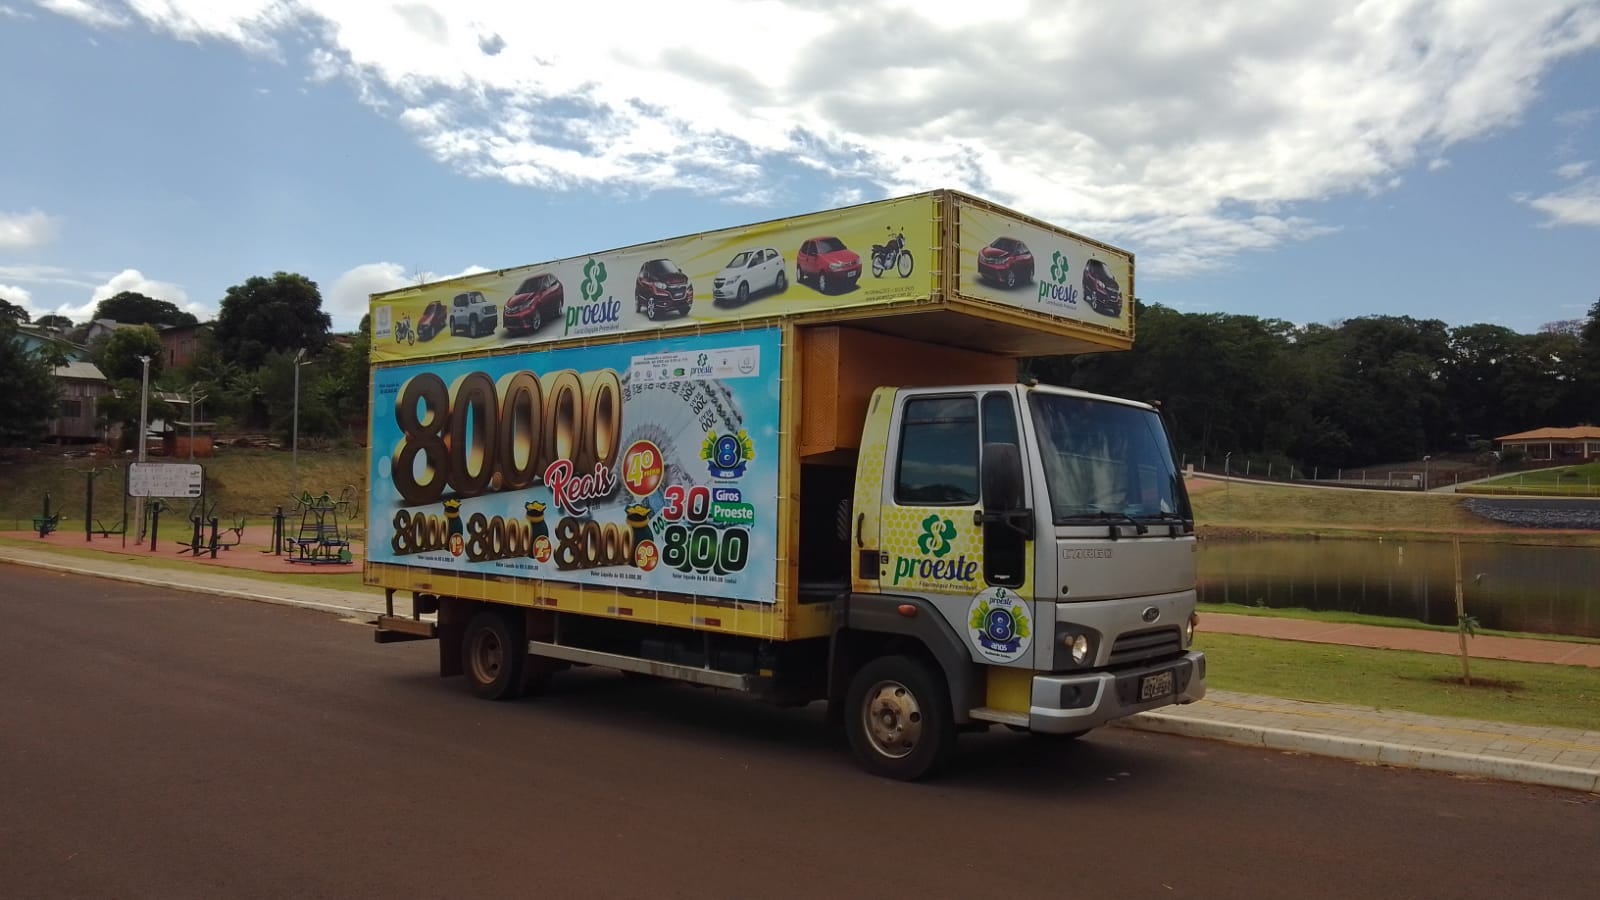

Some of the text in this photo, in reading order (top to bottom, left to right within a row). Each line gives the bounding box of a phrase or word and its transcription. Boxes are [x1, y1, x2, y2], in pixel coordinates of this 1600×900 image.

[1038, 278, 1078, 305] proeste
[565, 296, 621, 335] proeste
[693, 395, 707, 415] 200
[701, 413, 717, 432] 200
[718, 437, 737, 467] 8
[544, 459, 616, 517] Reais
[715, 490, 739, 502] Giros
[663, 485, 710, 523] 30
[713, 505, 753, 519] Proeste
[662, 524, 749, 573] 800
[893, 555, 978, 585] proeste
[989, 610, 1011, 640] 8
[991, 642, 1008, 651] anos
